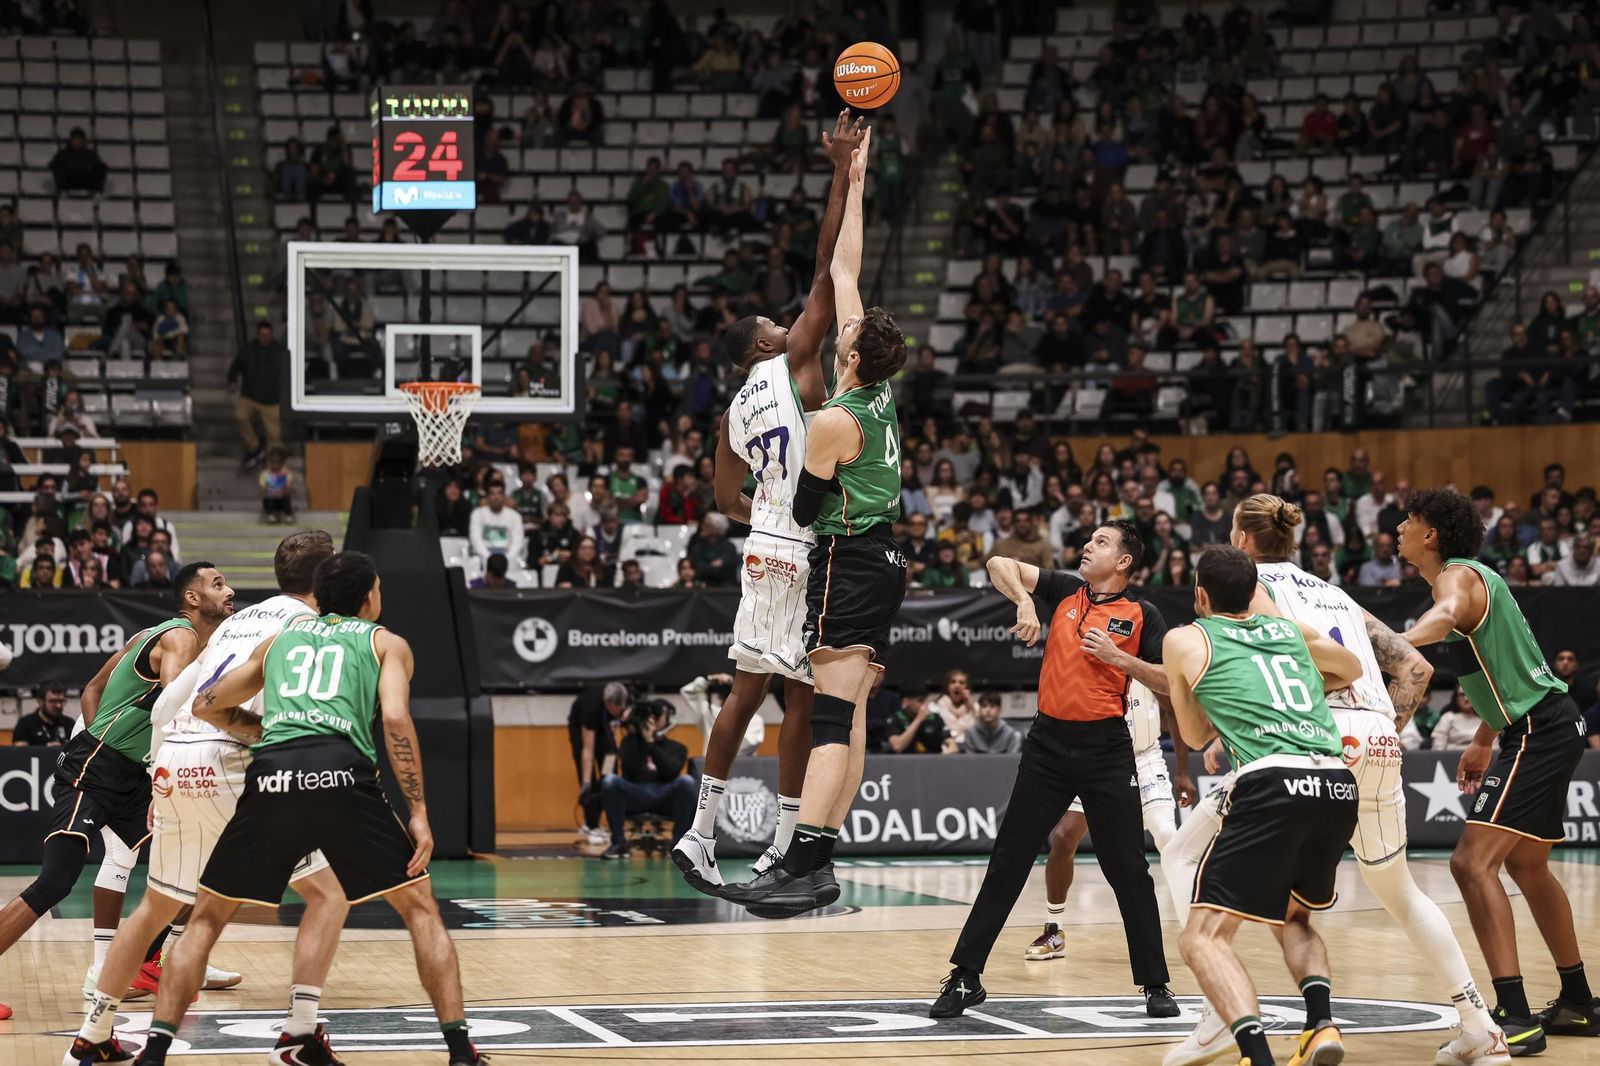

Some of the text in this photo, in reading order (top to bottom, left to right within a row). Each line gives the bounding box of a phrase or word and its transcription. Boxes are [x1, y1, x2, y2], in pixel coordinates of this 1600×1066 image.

[837, 62, 877, 77] Wilson
[392, 130, 463, 181] 24
[884, 423, 902, 477] 4
[765, 557, 798, 573] COSTA
[568, 629, 659, 647] Barcelona
[890, 623, 933, 646] pital
[1222, 622, 1295, 643] VIVES
[279, 644, 345, 701] 30
[1251, 654, 1313, 713] 16
[1368, 748, 1387, 758] DEL
[177, 766, 216, 777] COSTA
[257, 769, 355, 793] vdf team
[177, 779, 217, 789] DEL SOL
[860, 774, 891, 802] of
[1283, 775, 1321, 798] vdf
[840, 807, 998, 843] DALON
[1562, 821, 1600, 842] DA
